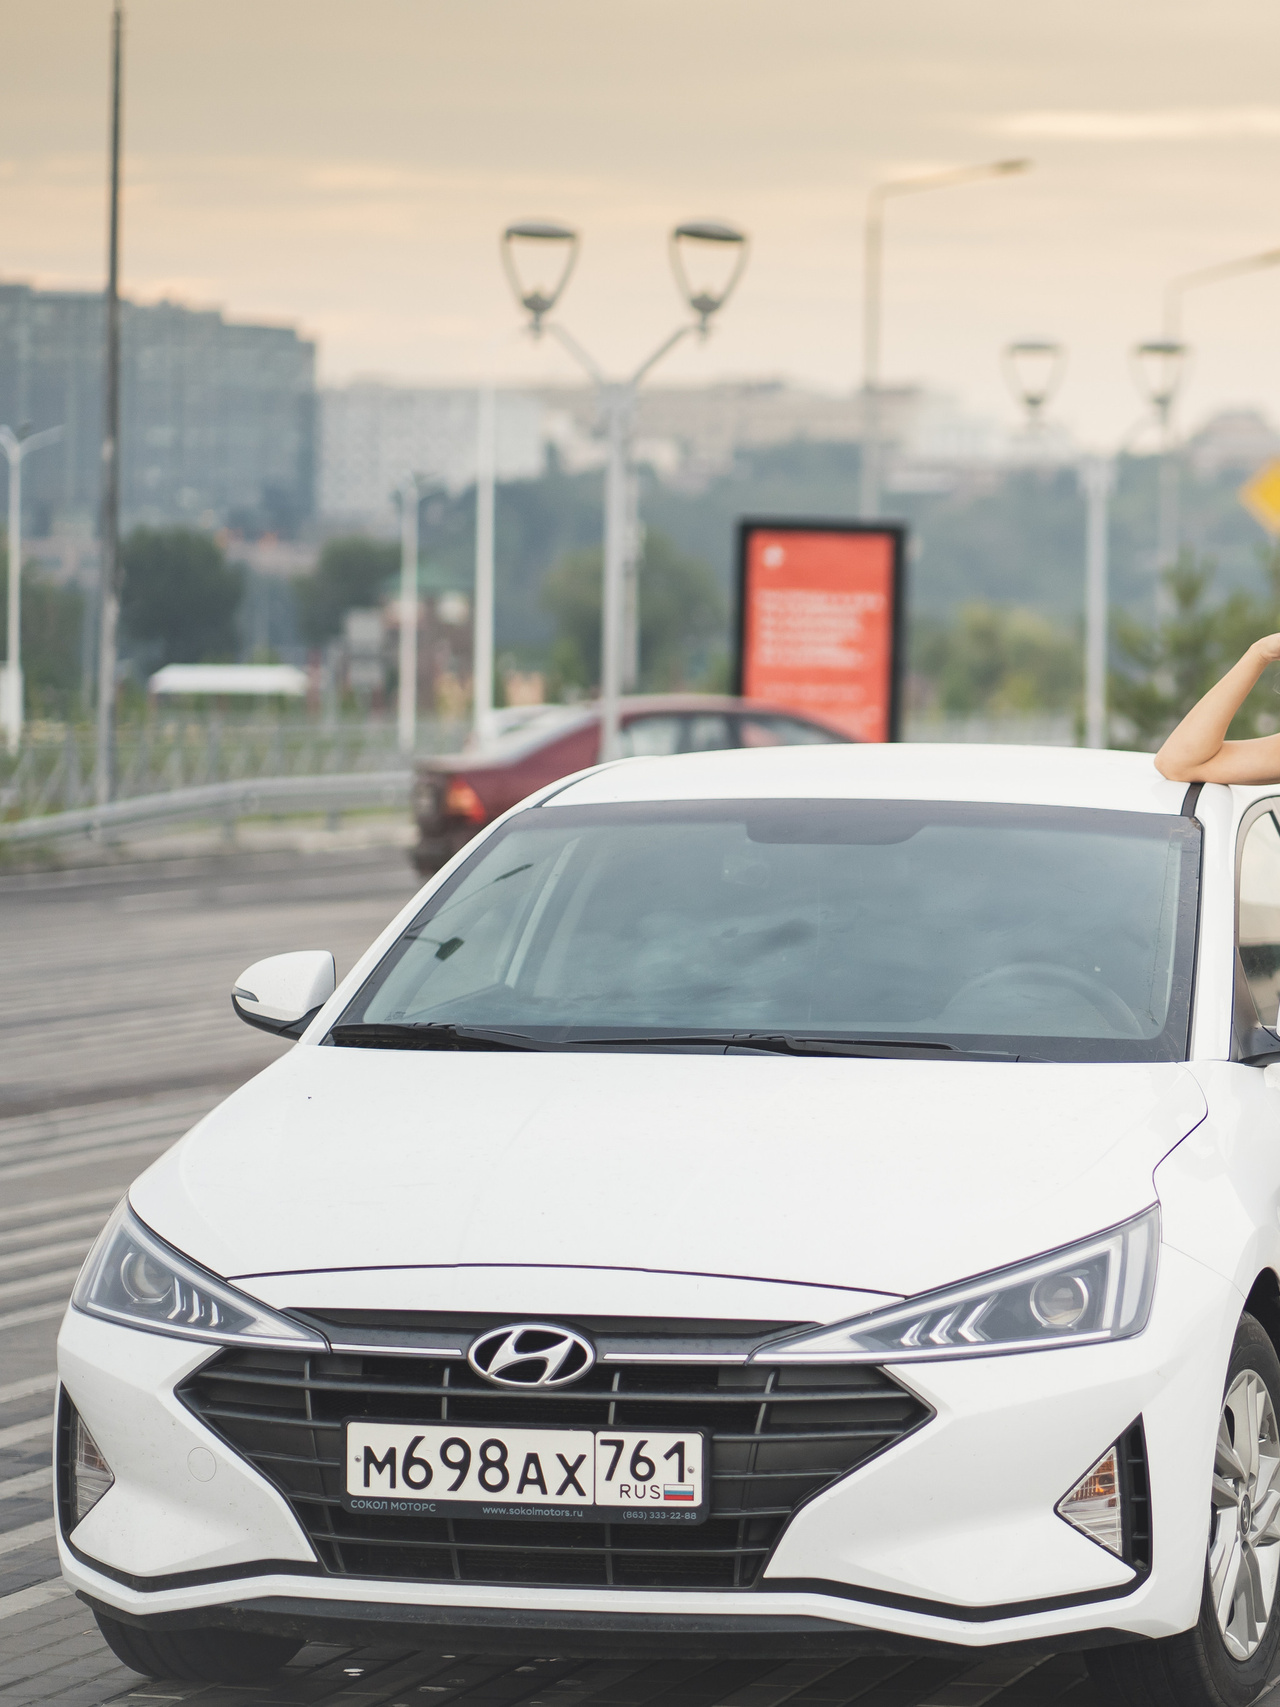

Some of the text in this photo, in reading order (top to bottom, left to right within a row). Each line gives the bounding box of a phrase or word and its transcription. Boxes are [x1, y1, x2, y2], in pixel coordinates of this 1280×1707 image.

[599, 1439, 686, 1483] 761
[620, 1484, 661, 1499] RUS
[351, 1500, 436, 1512] СОКОЛ МОТОРС
[483, 1505, 583, 1518] www.sokolmotors.ru
[623, 1510, 697, 1520] (863) 333-22-88
